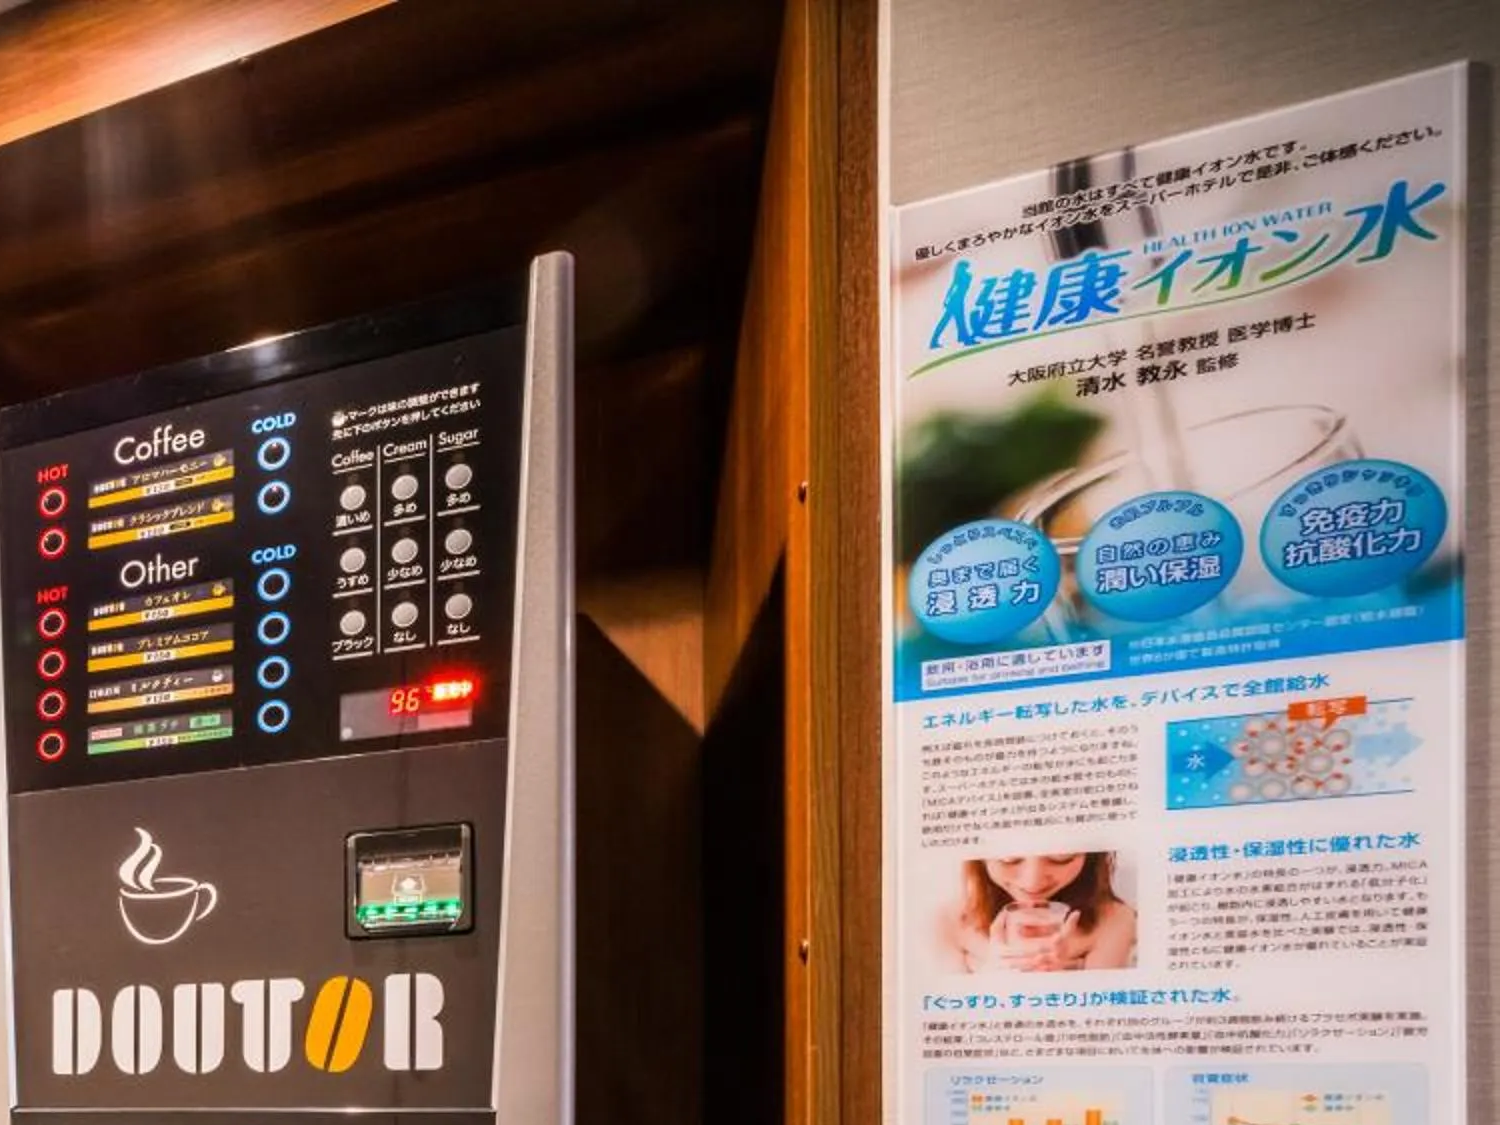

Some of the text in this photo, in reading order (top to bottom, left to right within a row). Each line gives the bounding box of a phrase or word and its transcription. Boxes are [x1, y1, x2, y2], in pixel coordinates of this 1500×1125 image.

[1262, 201, 1334, 227] WATER
[929, 180, 1446, 351] 健康イオン水
[1007, 348, 1128, 387] 大阪府立大学
[1227, 311, 1317, 344] 医学博士
[1075, 371, 1127, 398] 清水
[251, 411, 297, 435] COLD
[113, 423, 206, 465] Coffee
[331, 428, 480, 468] Coffee Cream Sugar
[36, 463, 70, 484] HOT
[392, 502, 418, 518] 多め
[446, 491, 472, 507] 多め
[1301, 497, 1406, 536] 免疫力
[251, 543, 297, 565] COLD
[1096, 530, 1222, 566] 自然の恵み
[1283, 527, 1422, 569] 抗酸化力
[120, 552, 200, 589] Other
[387, 564, 423, 582] 少なめ
[440, 555, 478, 574] 少なめ
[1096, 554, 1221, 594] 潤い保湿
[36, 585, 70, 605] HOT
[393, 630, 417, 644] なし
[446, 623, 472, 636] なし
[331, 636, 375, 653] ブラック
[390, 687, 421, 714] 96
[1186, 754, 1206, 770] 水
[51, 971, 446, 1076] DOUTOR
